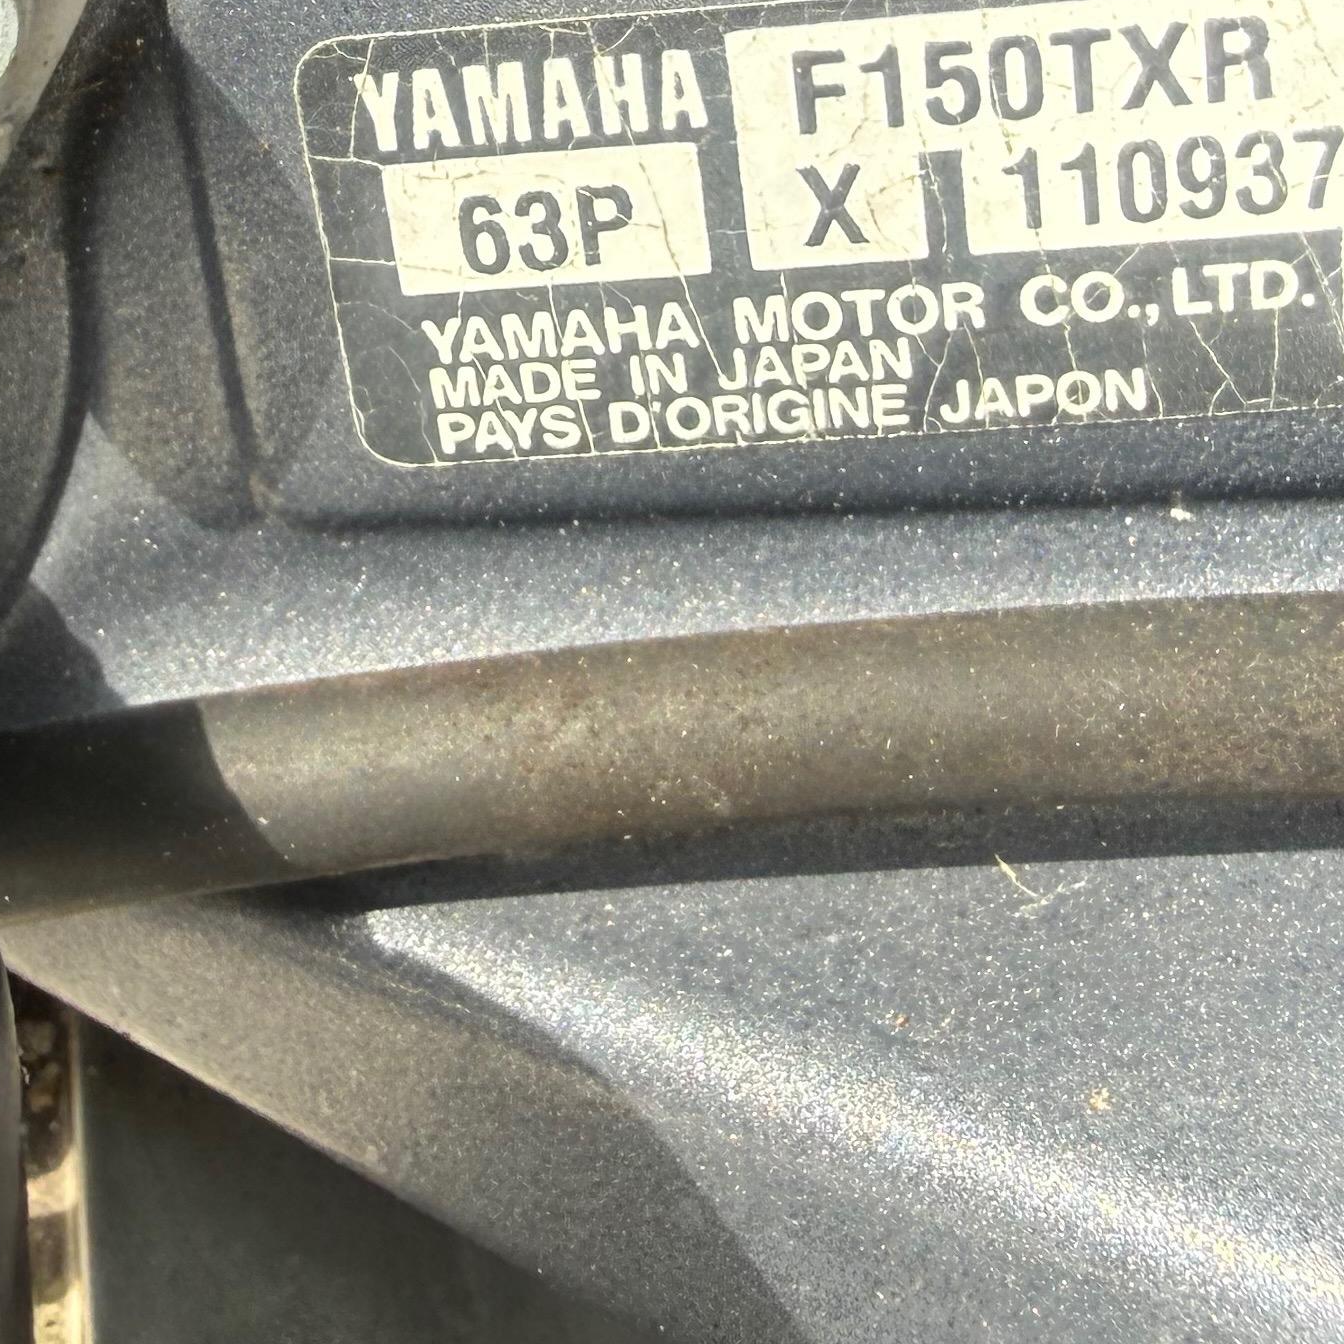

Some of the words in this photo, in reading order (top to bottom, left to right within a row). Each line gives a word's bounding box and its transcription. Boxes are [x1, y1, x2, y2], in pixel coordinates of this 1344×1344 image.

[354, 49, 709, 152] YAMAHA
[791, 15, 1275, 136] F150TXR
[458, 184, 634, 275] 63P
[794, 162, 871, 248] X
[420, 301, 700, 365] YAMAHA
[733, 280, 986, 344] MOTOR
[428, 358, 601, 409] MADE
[629, 353, 688, 396] IN
[718, 335, 913, 391] JAPAN
[435, 405, 582, 455] PAYS
[608, 382, 911, 444] D'ORIGINE
[939, 366, 1149, 424] JAPON
